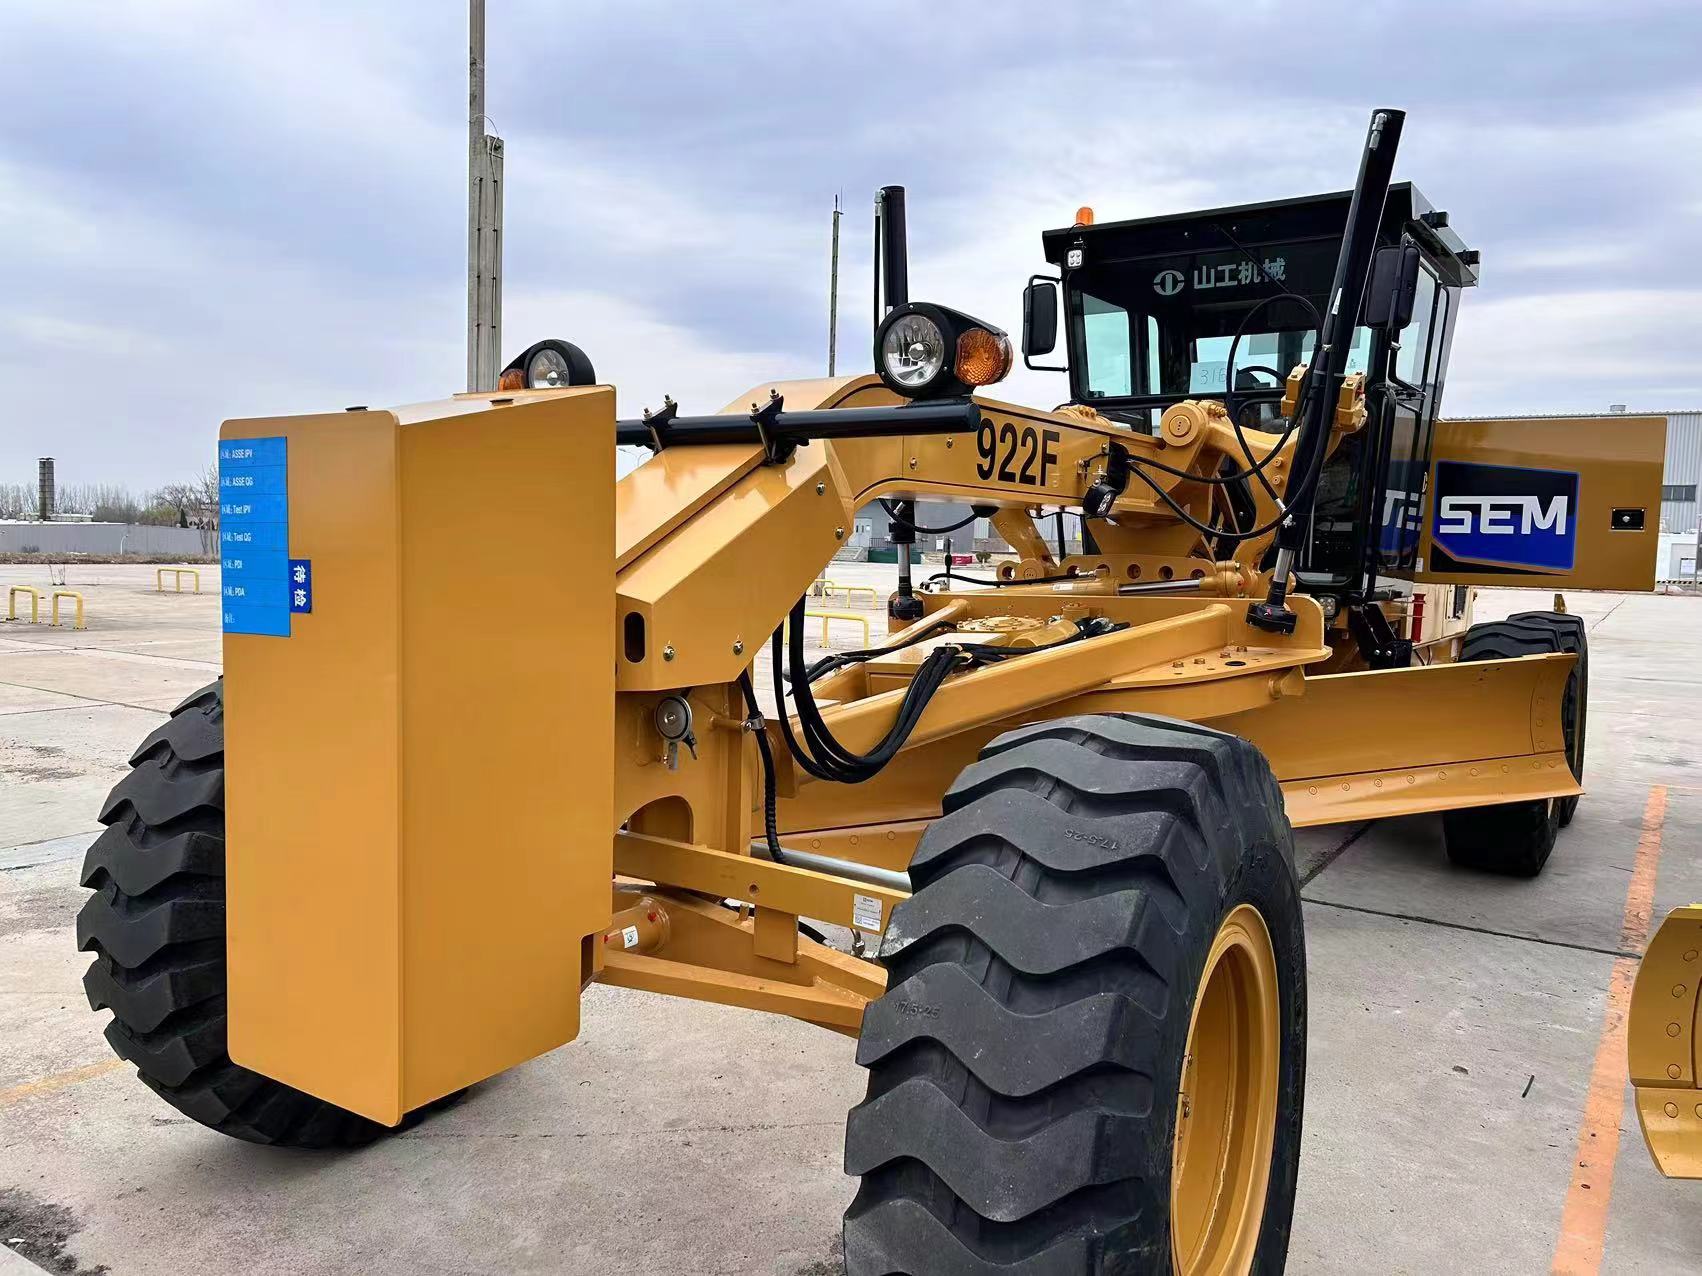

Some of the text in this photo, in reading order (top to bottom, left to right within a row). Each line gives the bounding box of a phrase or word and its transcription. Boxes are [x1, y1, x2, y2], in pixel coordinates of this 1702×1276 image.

[1193, 257, 1286, 289] 山工机械
[976, 417, 1060, 487] 922F
[1439, 495, 1568, 535] SEM
[234, 532, 243, 541] Test
[293, 565, 307, 607] 待检
